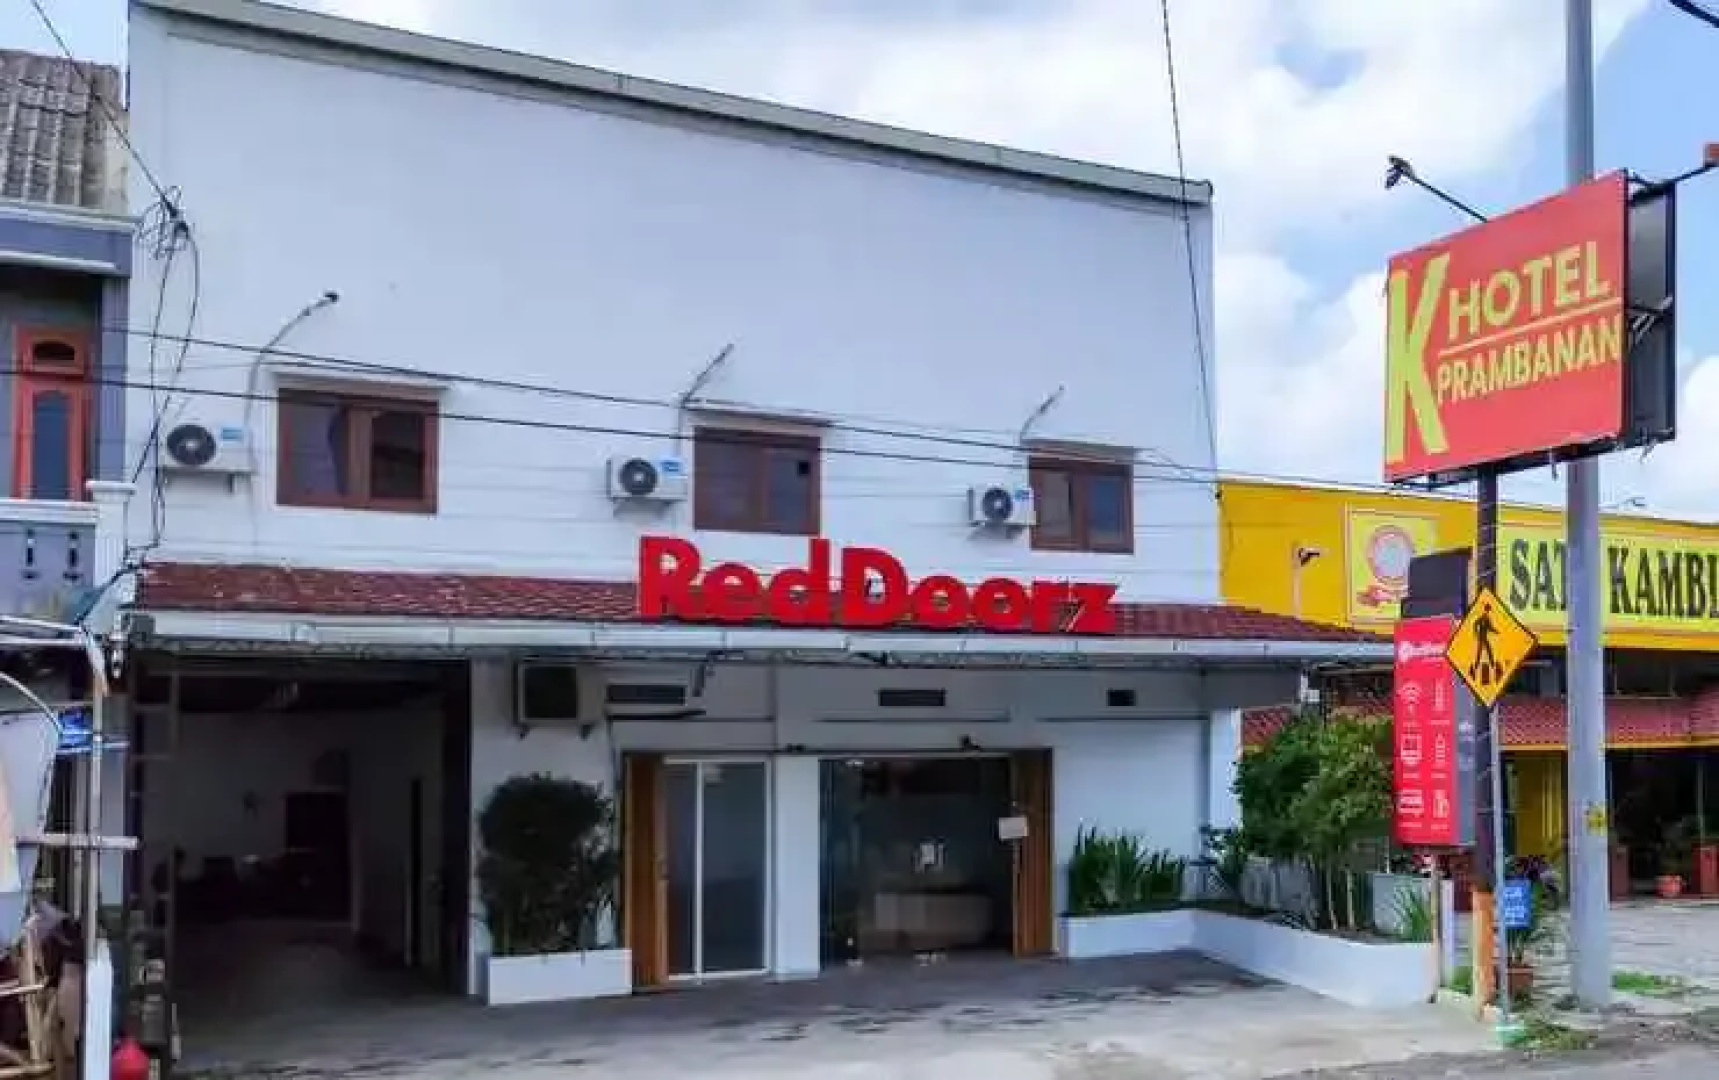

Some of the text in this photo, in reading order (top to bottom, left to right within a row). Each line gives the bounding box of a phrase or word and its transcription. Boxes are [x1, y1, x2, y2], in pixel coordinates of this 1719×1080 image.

[1386, 241, 1610, 464] K HOTEL
[1437, 313, 1622, 405] PRAMBANAN
[639, 535, 1118, 634] RedDoorz
